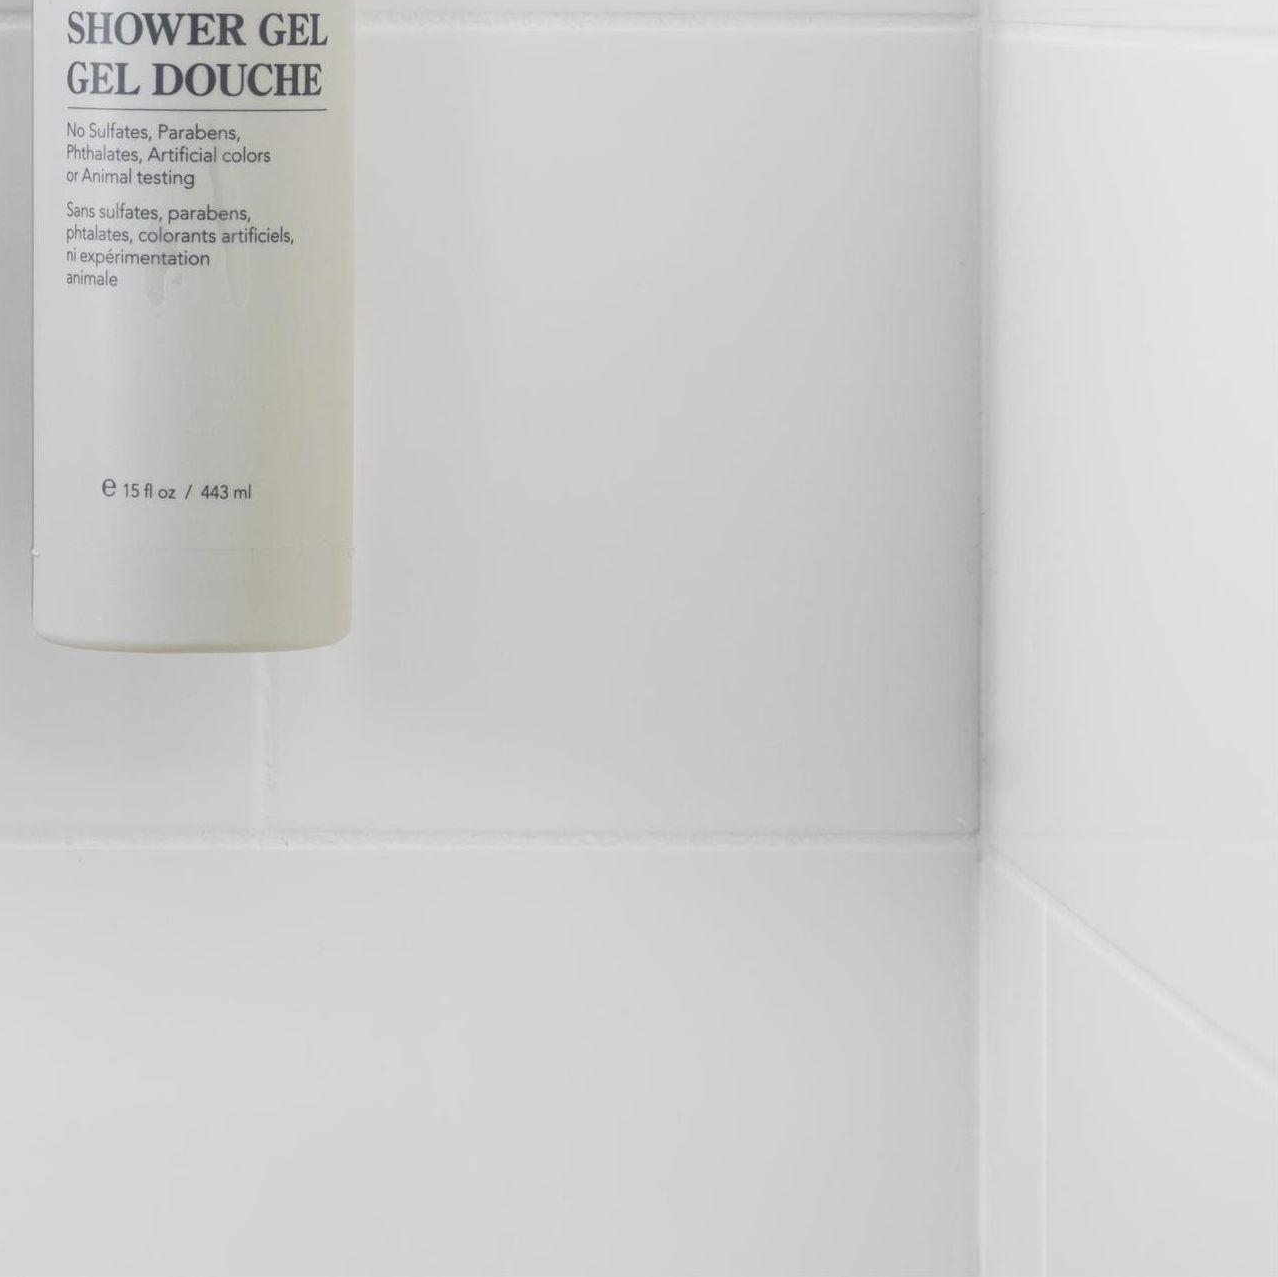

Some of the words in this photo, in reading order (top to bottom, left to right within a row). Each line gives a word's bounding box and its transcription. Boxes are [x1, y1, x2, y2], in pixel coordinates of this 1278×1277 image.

[67, 11, 247, 46] SHOWER
[259, 12, 328, 46] GEL
[67, 61, 140, 95] GEL
[152, 63, 322, 96] DOUCHE
[66, 122, 85, 138] No
[89, 122, 152, 141] Sulfates,
[158, 124, 240, 142] Parabens,
[66, 145, 142, 164] Phthalates,
[148, 146, 217, 162] Artificial
[222, 147, 271, 162] colors
[66, 170, 79, 183] or
[82, 169, 132, 184] Animal
[138, 170, 195, 189] testing
[66, 202, 95, 218] Sans
[99, 203, 163, 222] sulfates,
[168, 205, 251, 224] parabens,
[66, 225, 133, 244] phtalates,
[139, 227, 216, 243] colorants
[222, 227, 294, 244] artificiels,
[66, 250, 76, 262] ni
[80, 250, 210, 267] expérimentation
[66, 271, 118, 287] animale
[123, 484, 140, 498] 15
[144, 484, 153, 498] fl
[158, 487, 176, 500] oz
[201, 484, 229, 499] 443
[233, 484, 252, 499] ml
